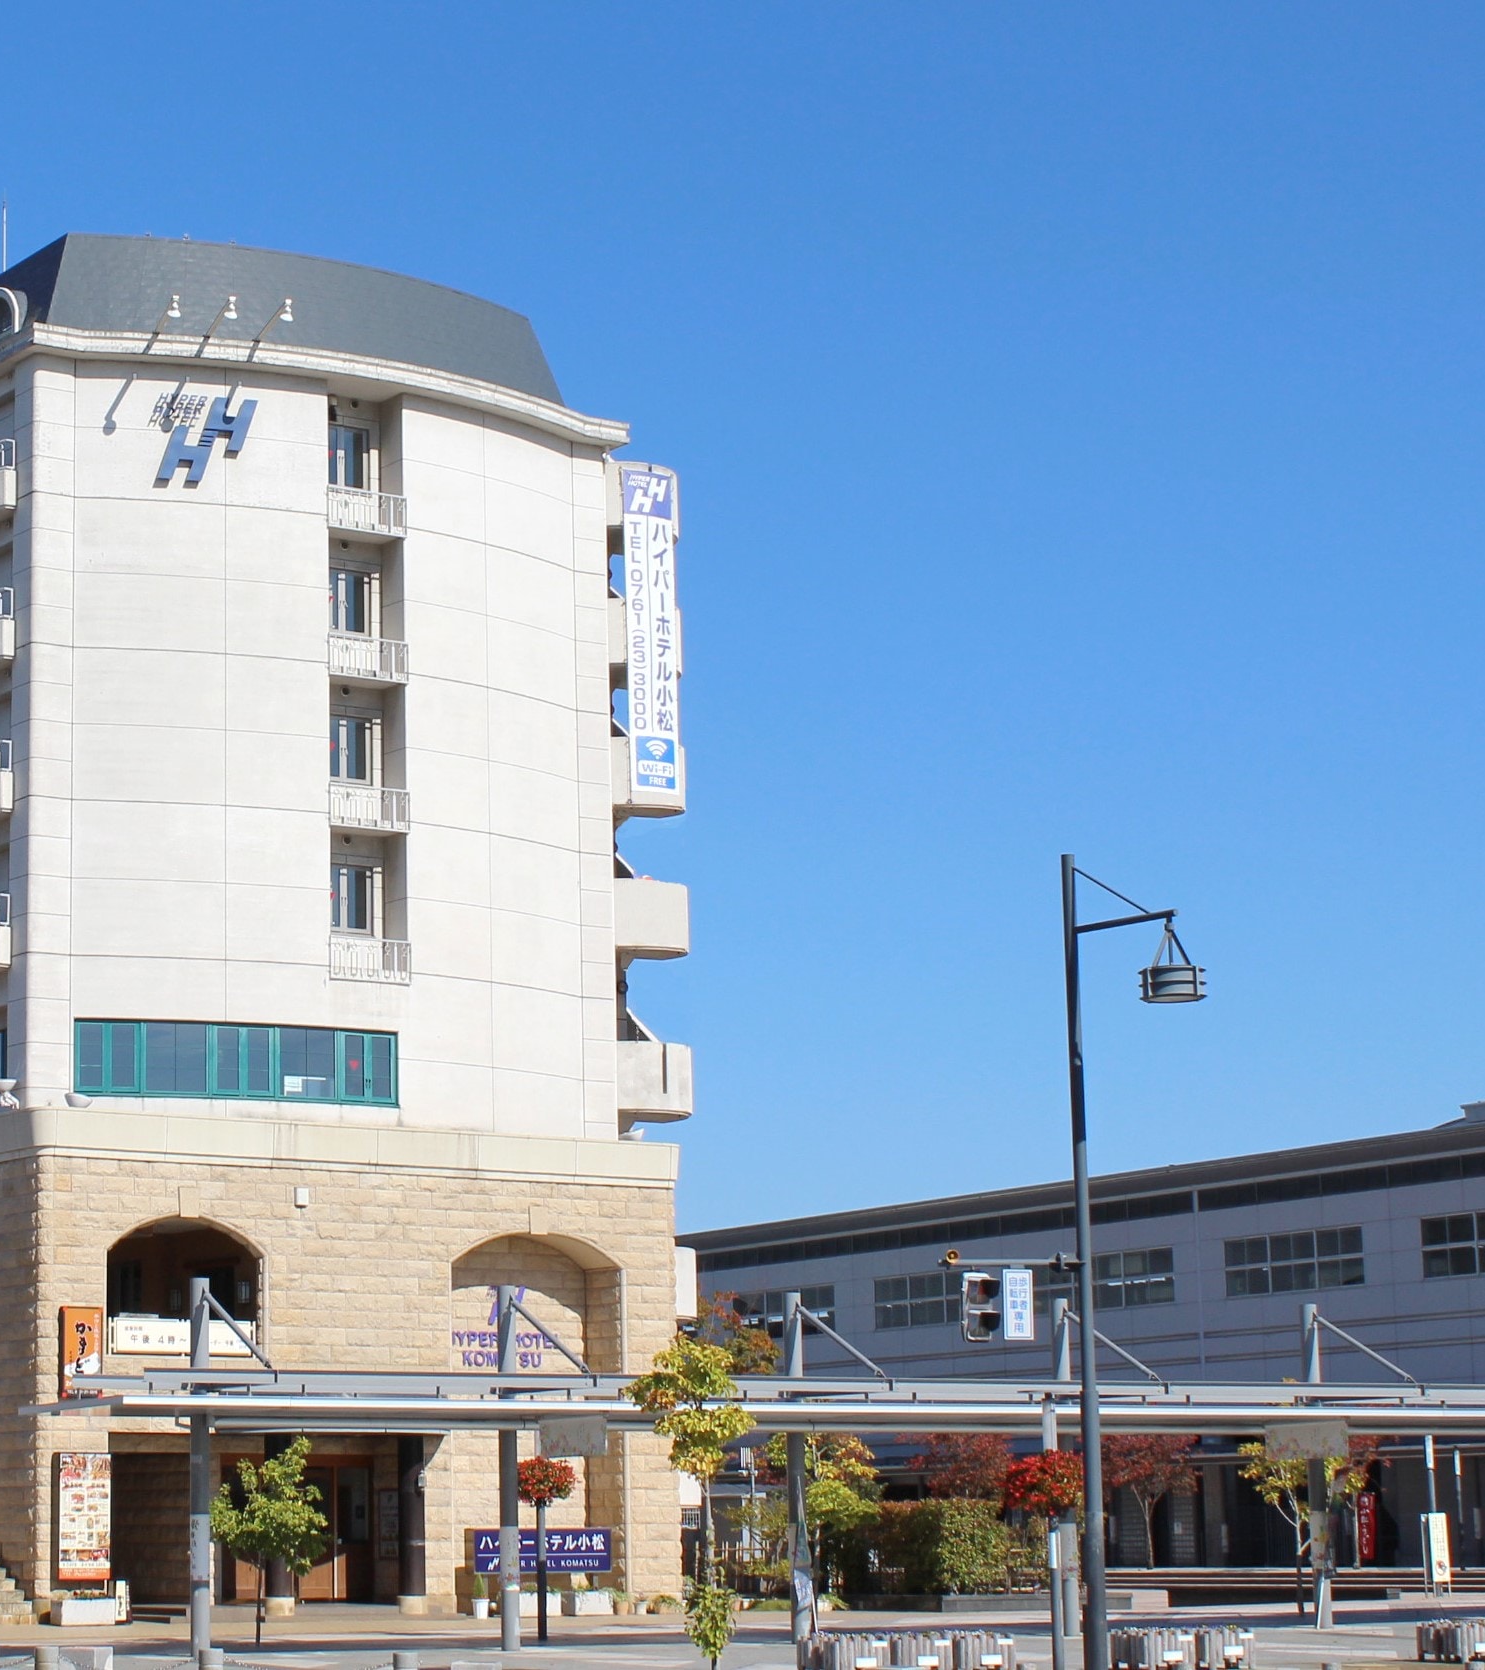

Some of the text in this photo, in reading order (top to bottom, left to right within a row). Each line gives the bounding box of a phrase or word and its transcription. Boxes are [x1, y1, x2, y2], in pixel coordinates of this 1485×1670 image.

[652, 523, 674, 733] ハイパーホテル小松
[642, 763, 672, 775] Wi-Fi
[648, 776, 668, 787] FREE
[561, 1559, 599, 1567] KOMATSU
